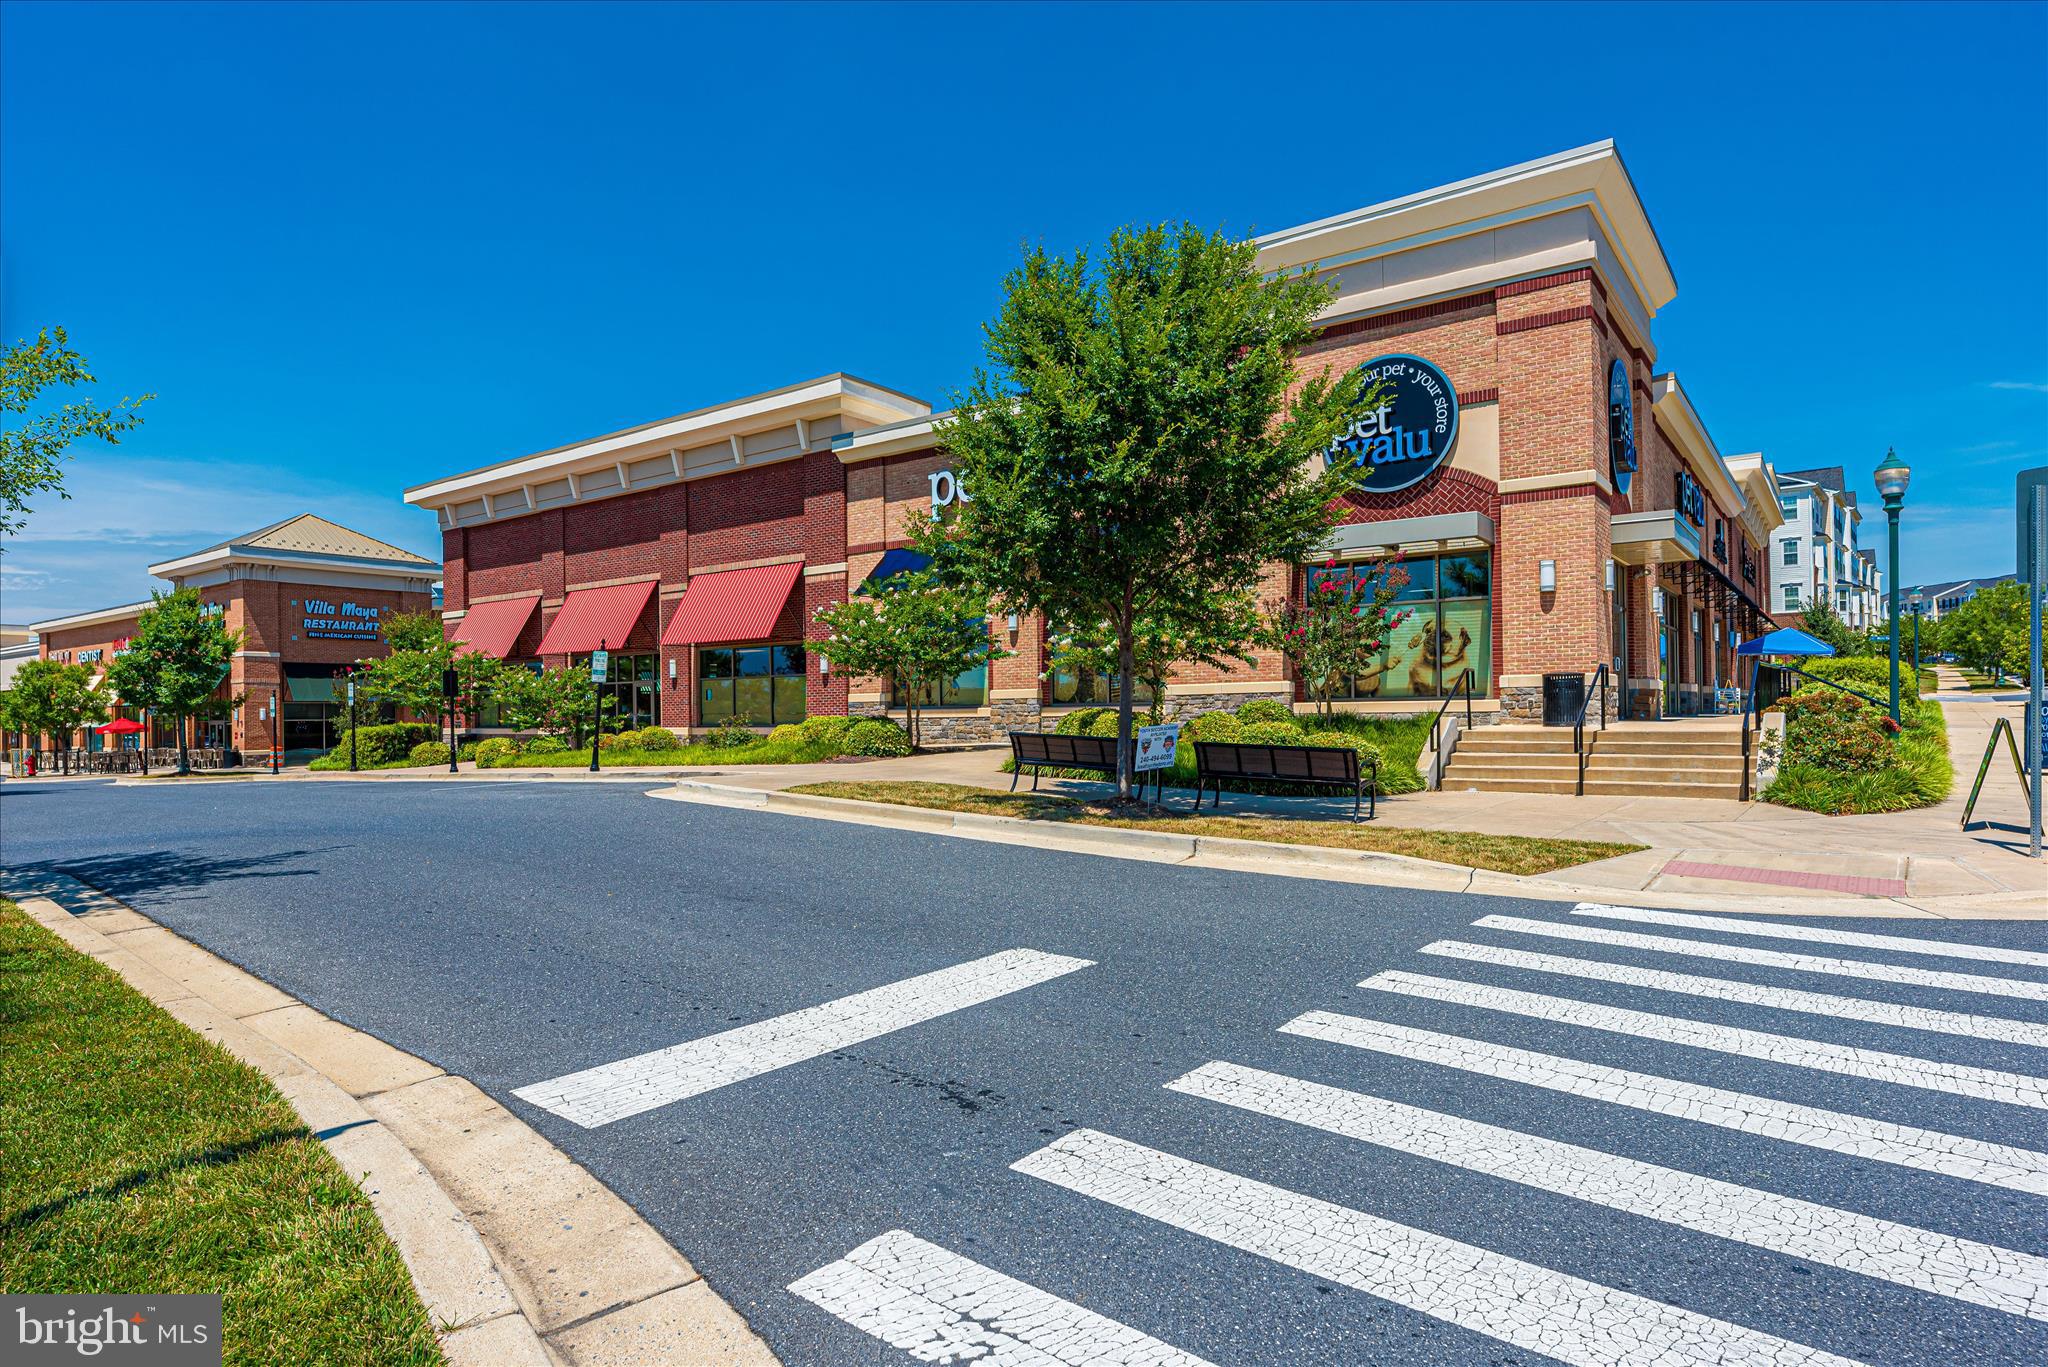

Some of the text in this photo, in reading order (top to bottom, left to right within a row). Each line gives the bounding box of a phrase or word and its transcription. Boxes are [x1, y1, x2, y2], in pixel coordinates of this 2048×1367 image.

[1362, 362, 1448, 434] our pet your store
[1346, 425, 1432, 467] valu
[927, 468, 976, 523] pe
[303, 618, 380, 632] RESTAURANT
[304, 599, 378, 620] Villa Maya
[78, 649, 101, 663] DENTIST
